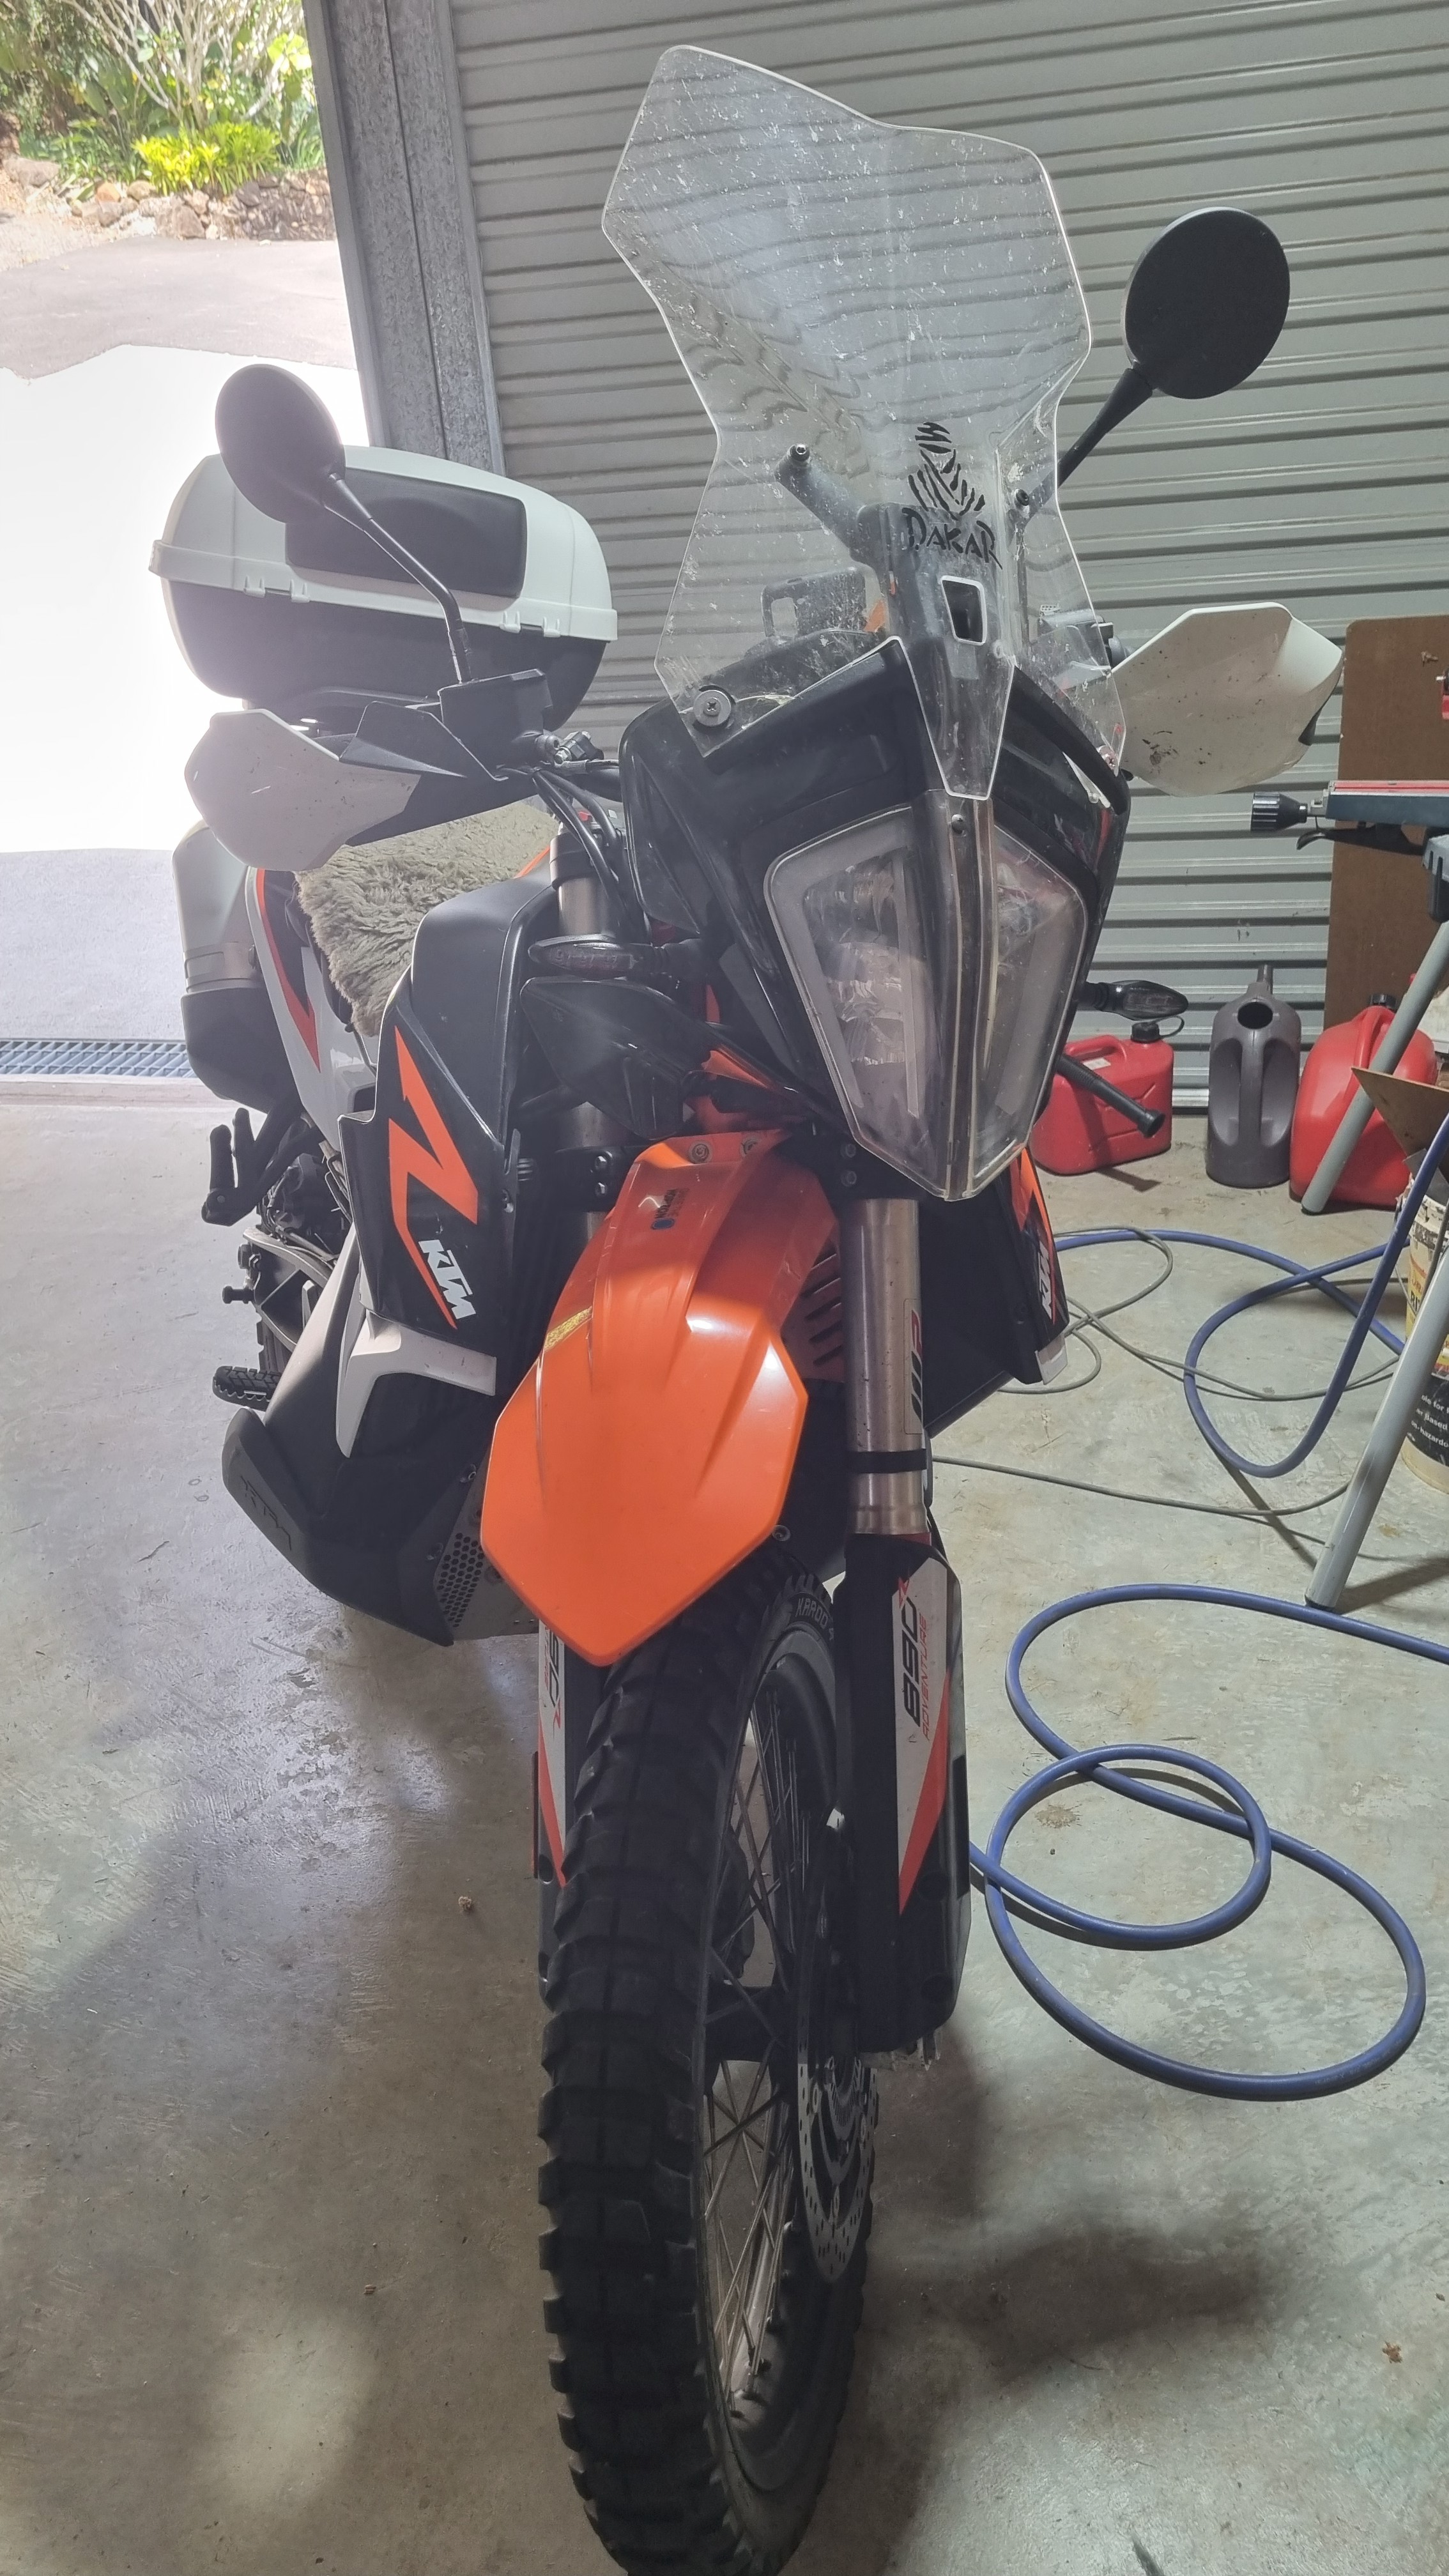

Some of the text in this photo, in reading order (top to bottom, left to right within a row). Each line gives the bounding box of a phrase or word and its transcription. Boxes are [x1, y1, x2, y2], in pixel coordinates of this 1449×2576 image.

[901, 507, 1003, 570] DAKAR
[418, 1239, 477, 1320] KTM
[1038, 1241, 1052, 1320] KTM
[795, 1597, 829, 1629] KAROO
[901, 1596, 921, 1728] 890
[919, 1611, 930, 1741] ADVENTURE
